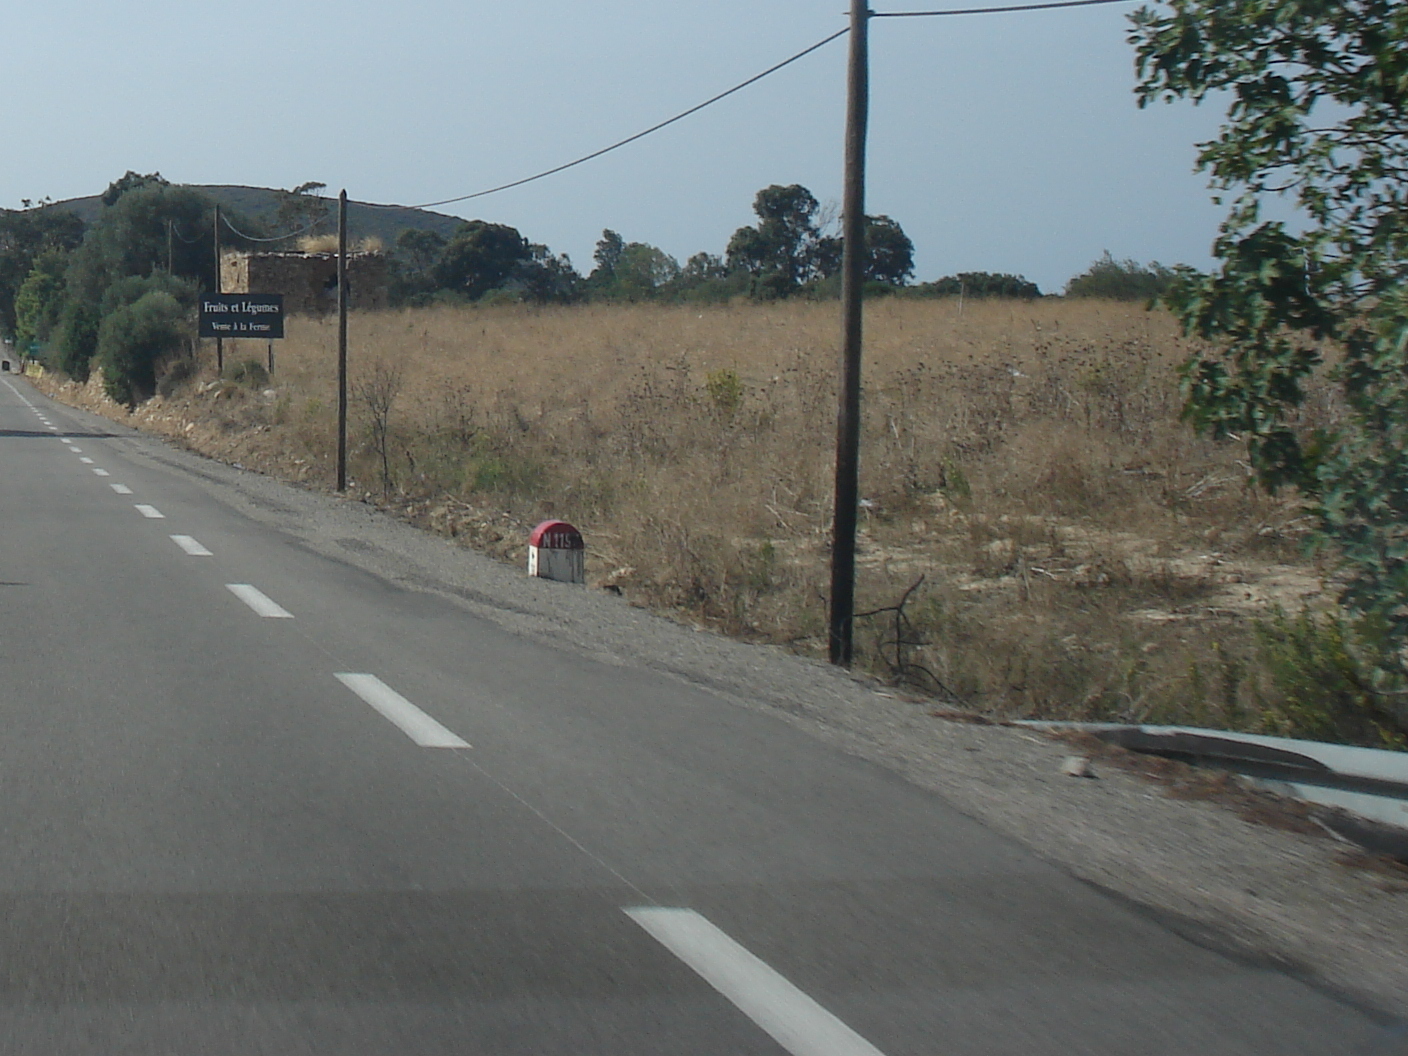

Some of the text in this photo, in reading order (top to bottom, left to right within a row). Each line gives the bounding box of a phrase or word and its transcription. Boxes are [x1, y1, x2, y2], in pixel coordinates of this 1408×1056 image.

[204, 301, 279, 316] Fruits et Légumes
[249, 321, 271, 331] Ferme
